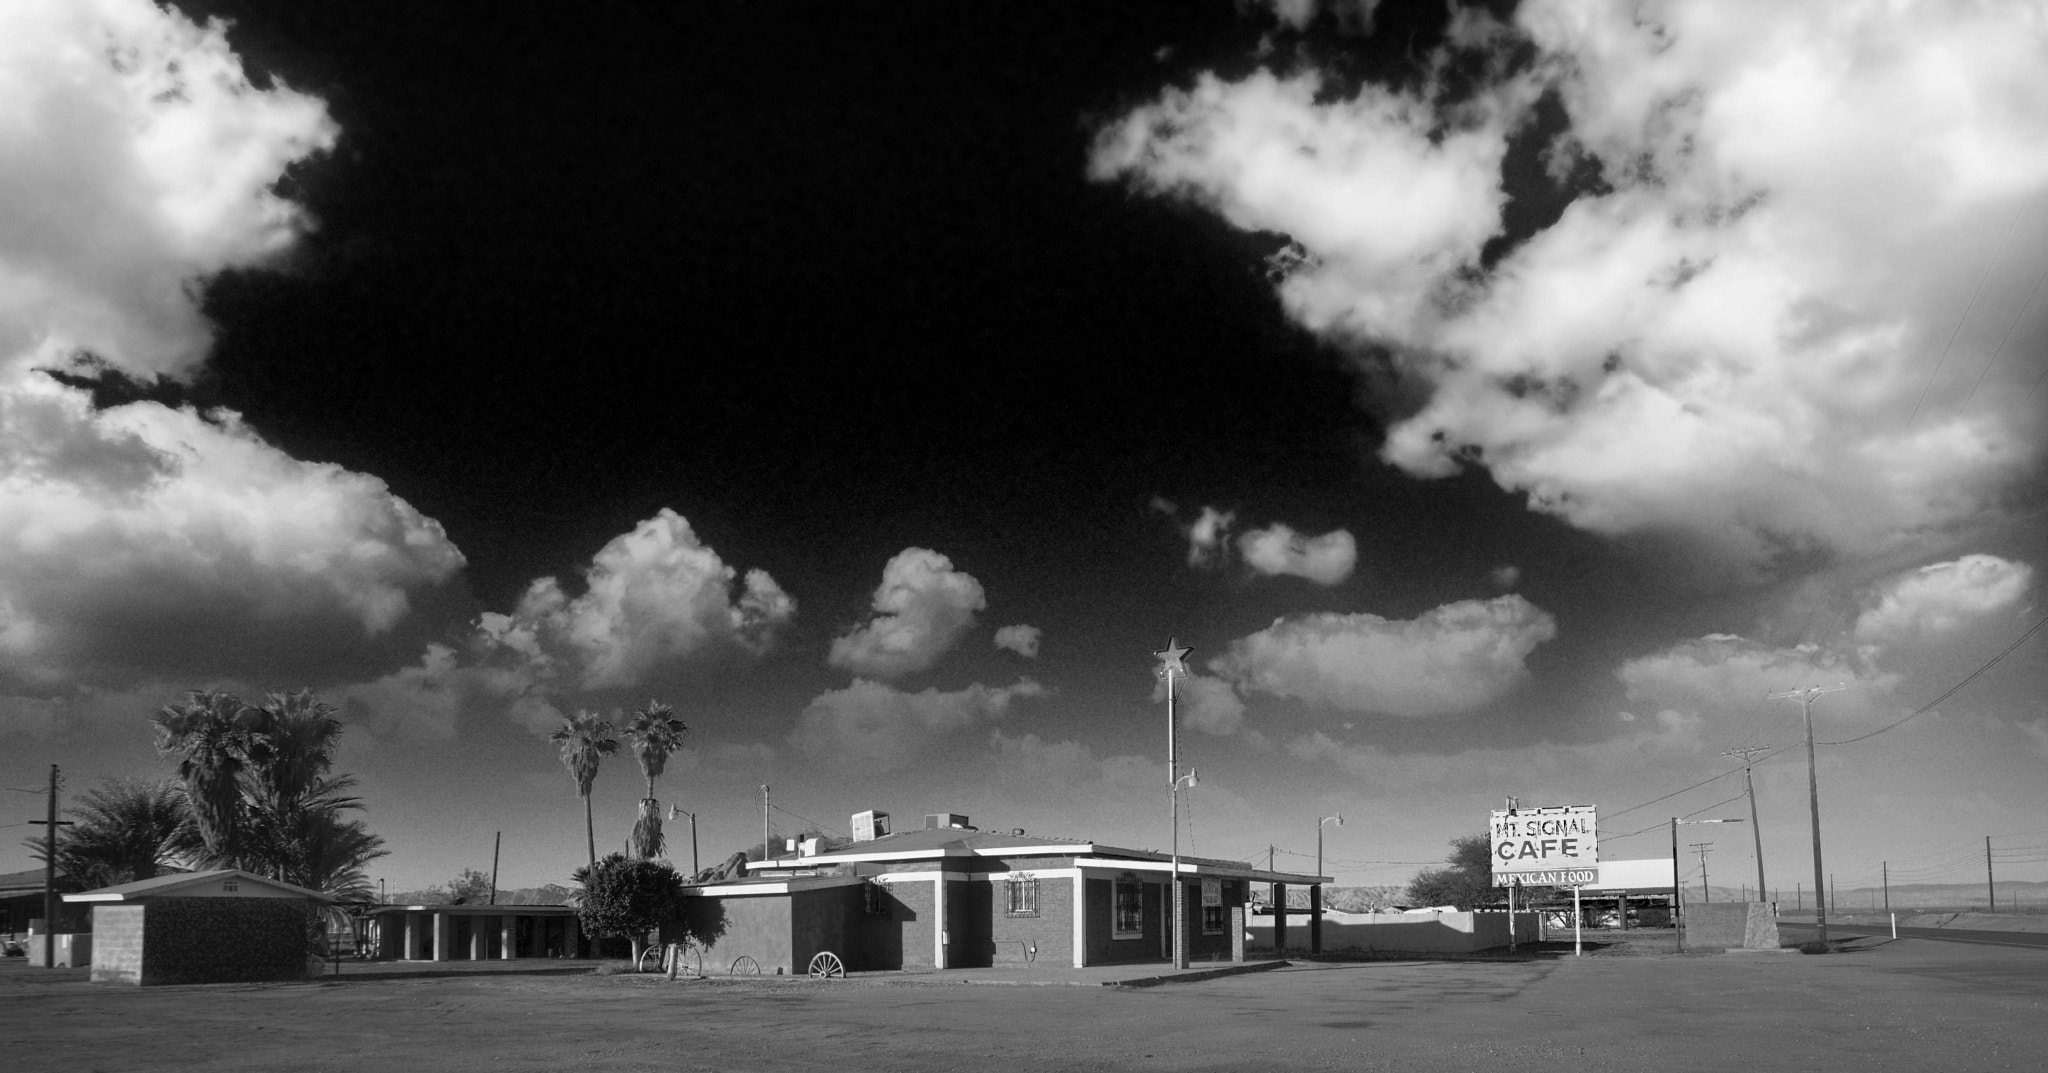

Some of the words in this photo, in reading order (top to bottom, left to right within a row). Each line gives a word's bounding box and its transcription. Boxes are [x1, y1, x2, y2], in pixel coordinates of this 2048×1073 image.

[1496, 823, 1521, 838] MT.
[1526, 818, 1592, 837] SIGNAL
[1497, 838, 1579, 860] CAFE
[1496, 871, 1557, 885] MEXICAN
[1560, 871, 1594, 883] FOOD
